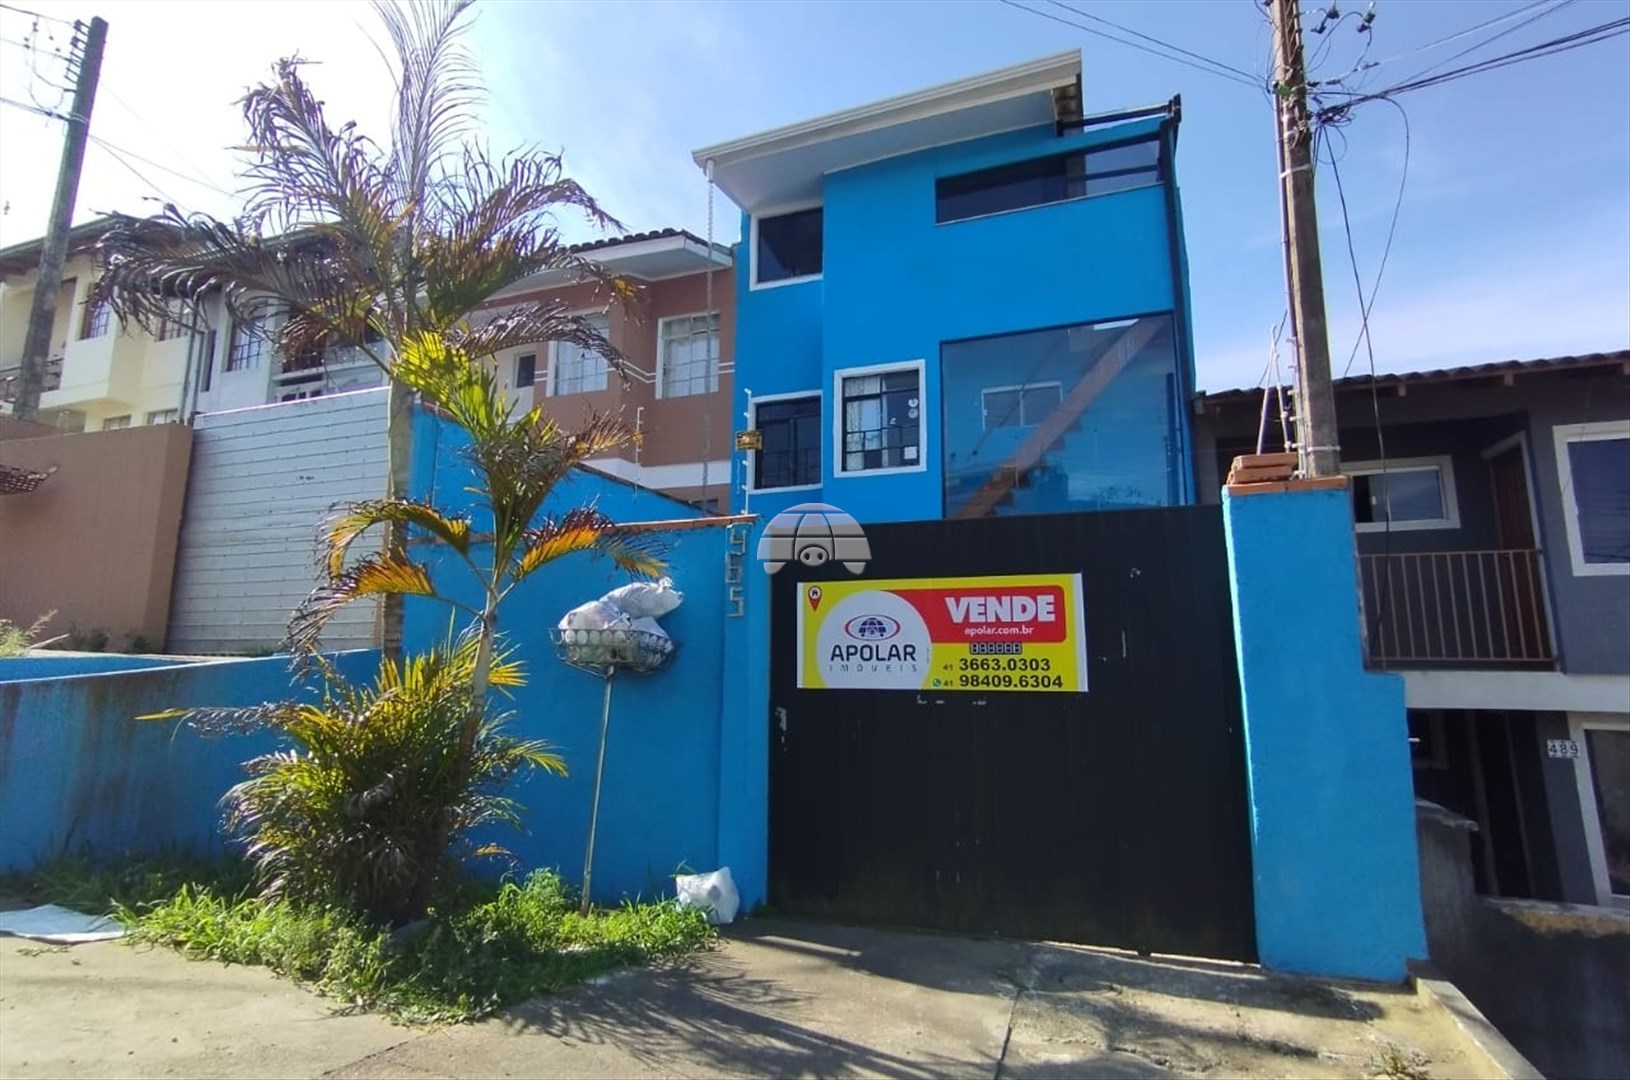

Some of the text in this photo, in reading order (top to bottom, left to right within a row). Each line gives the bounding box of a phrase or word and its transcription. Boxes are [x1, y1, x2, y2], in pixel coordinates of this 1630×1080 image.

[945, 595, 1055, 624] VENDE
[964, 625, 1034, 637] apolar.com.br
[830, 644, 917, 661] APOLAR
[959, 658, 1051, 671] 3663.0303
[959, 675, 1063, 688] 98409.6304
[1549, 743, 1578, 755] 489
